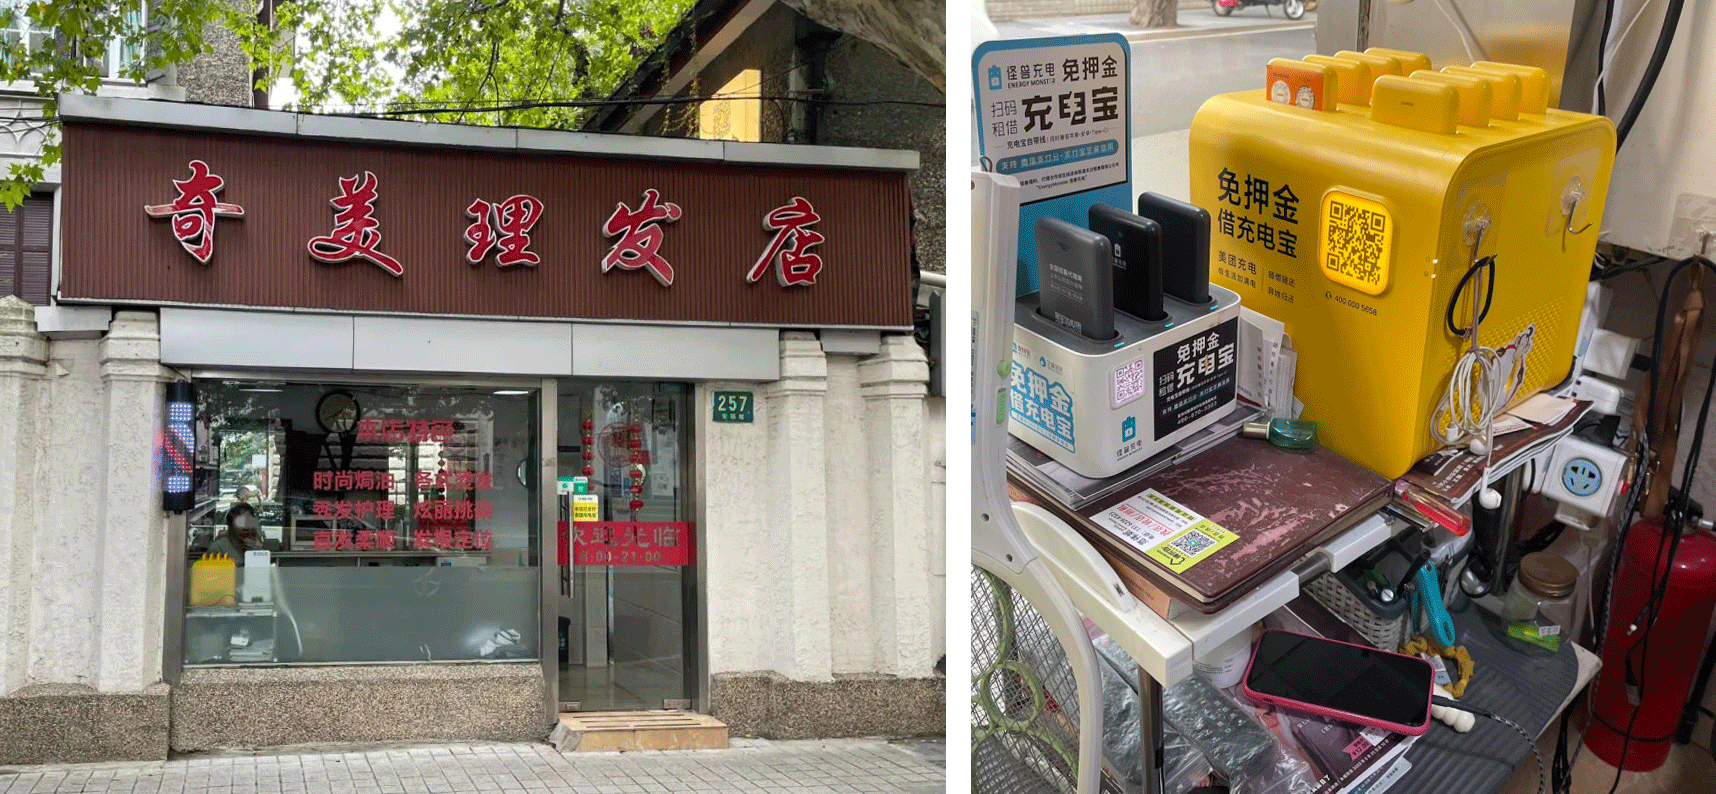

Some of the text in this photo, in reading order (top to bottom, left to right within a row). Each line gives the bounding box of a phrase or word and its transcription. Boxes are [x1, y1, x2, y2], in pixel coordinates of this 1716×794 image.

[1006, 62, 1055, 81] 怪兽充电
[1062, 55, 1118, 82] 免押金
[991, 100, 1017, 118] 扫码
[1021, 86, 1118, 133] 充电宝
[992, 119, 1018, 137] 租借
[1217, 167, 1299, 225] 免押金
[144, 160, 825, 287] 奇美理发店
[1217, 207, 1298, 259] 借充电宝
[1218, 250, 1257, 276] 美团充电
[1177, 331, 1220, 364] 免押金
[1176, 342, 1235, 389] 充电宝
[718, 395, 747, 411] 257
[1011, 362, 1071, 418] 免押金
[1011, 389, 1072, 440] 借充电宝
[313, 471, 395, 491] 时尚焗油
[313, 501, 395, 520] 秀发护理
